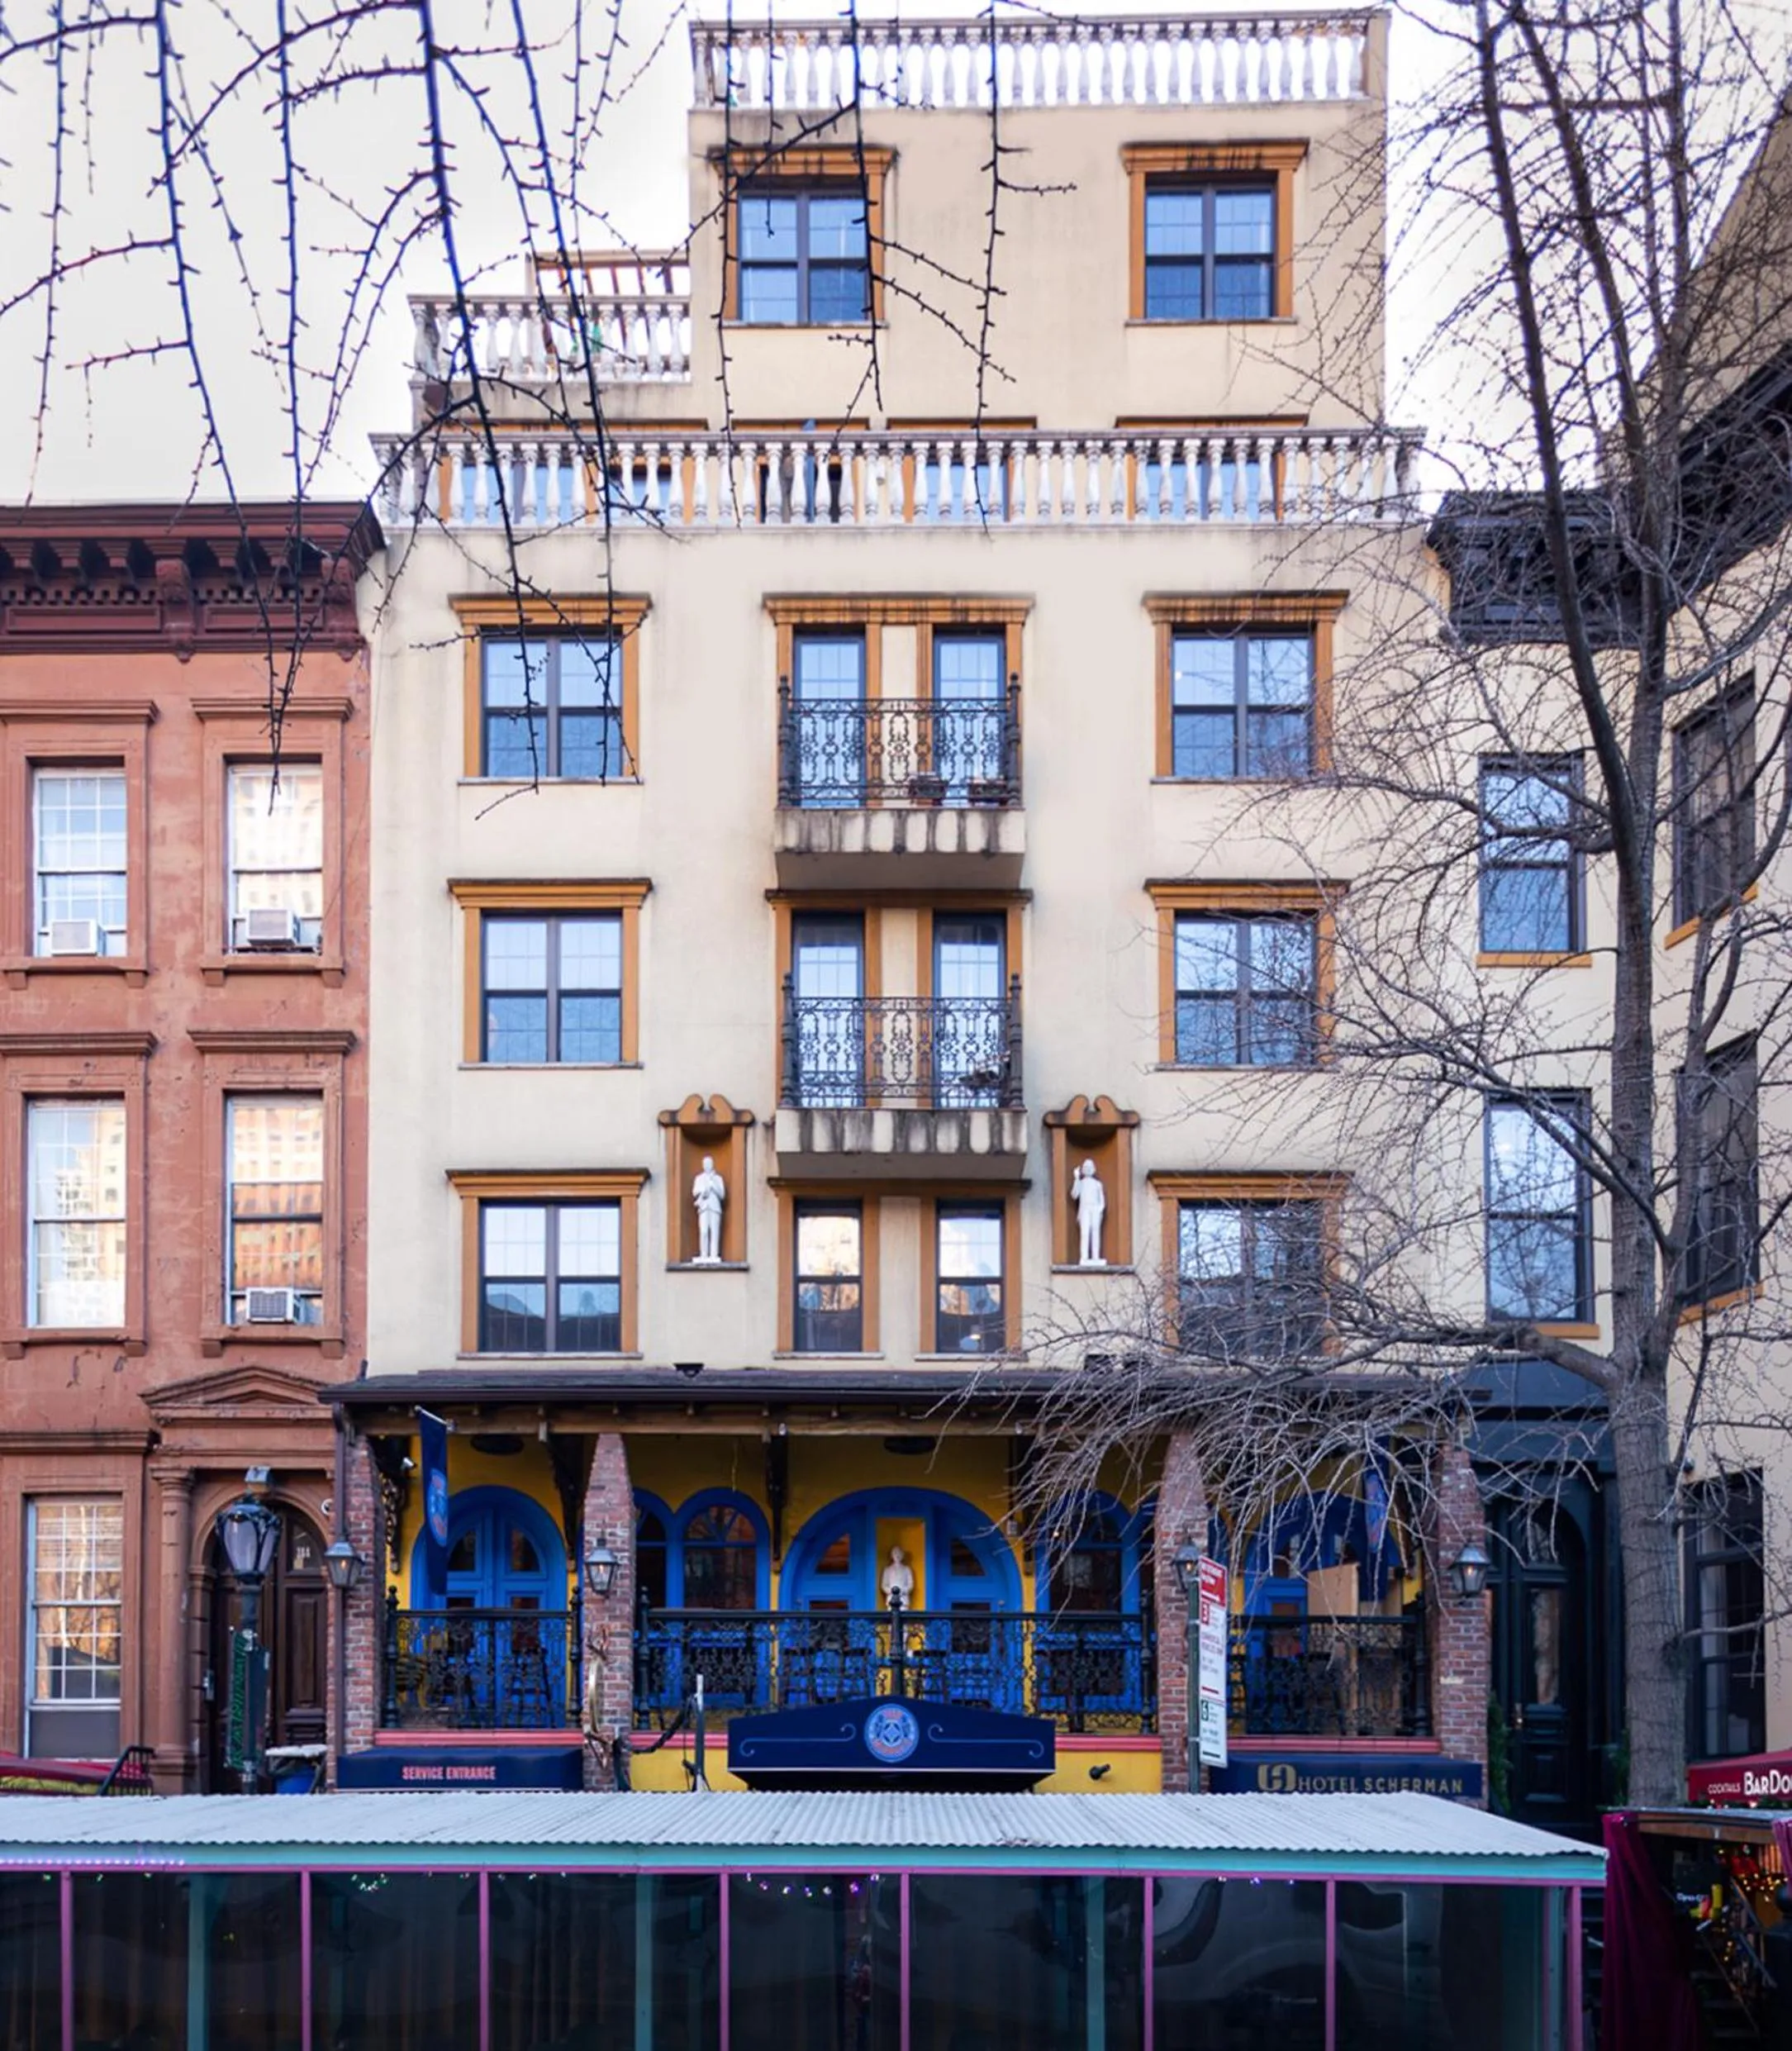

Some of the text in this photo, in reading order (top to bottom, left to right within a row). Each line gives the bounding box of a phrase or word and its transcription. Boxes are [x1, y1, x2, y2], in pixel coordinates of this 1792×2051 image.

[402, 1767, 496, 1780] SERVICE ENTRANCE
[1744, 1769, 1792, 1796] BARDO
[1298, 1776, 1359, 1792] HOTEL
[1364, 1777, 1463, 1794] SCHERMAN
